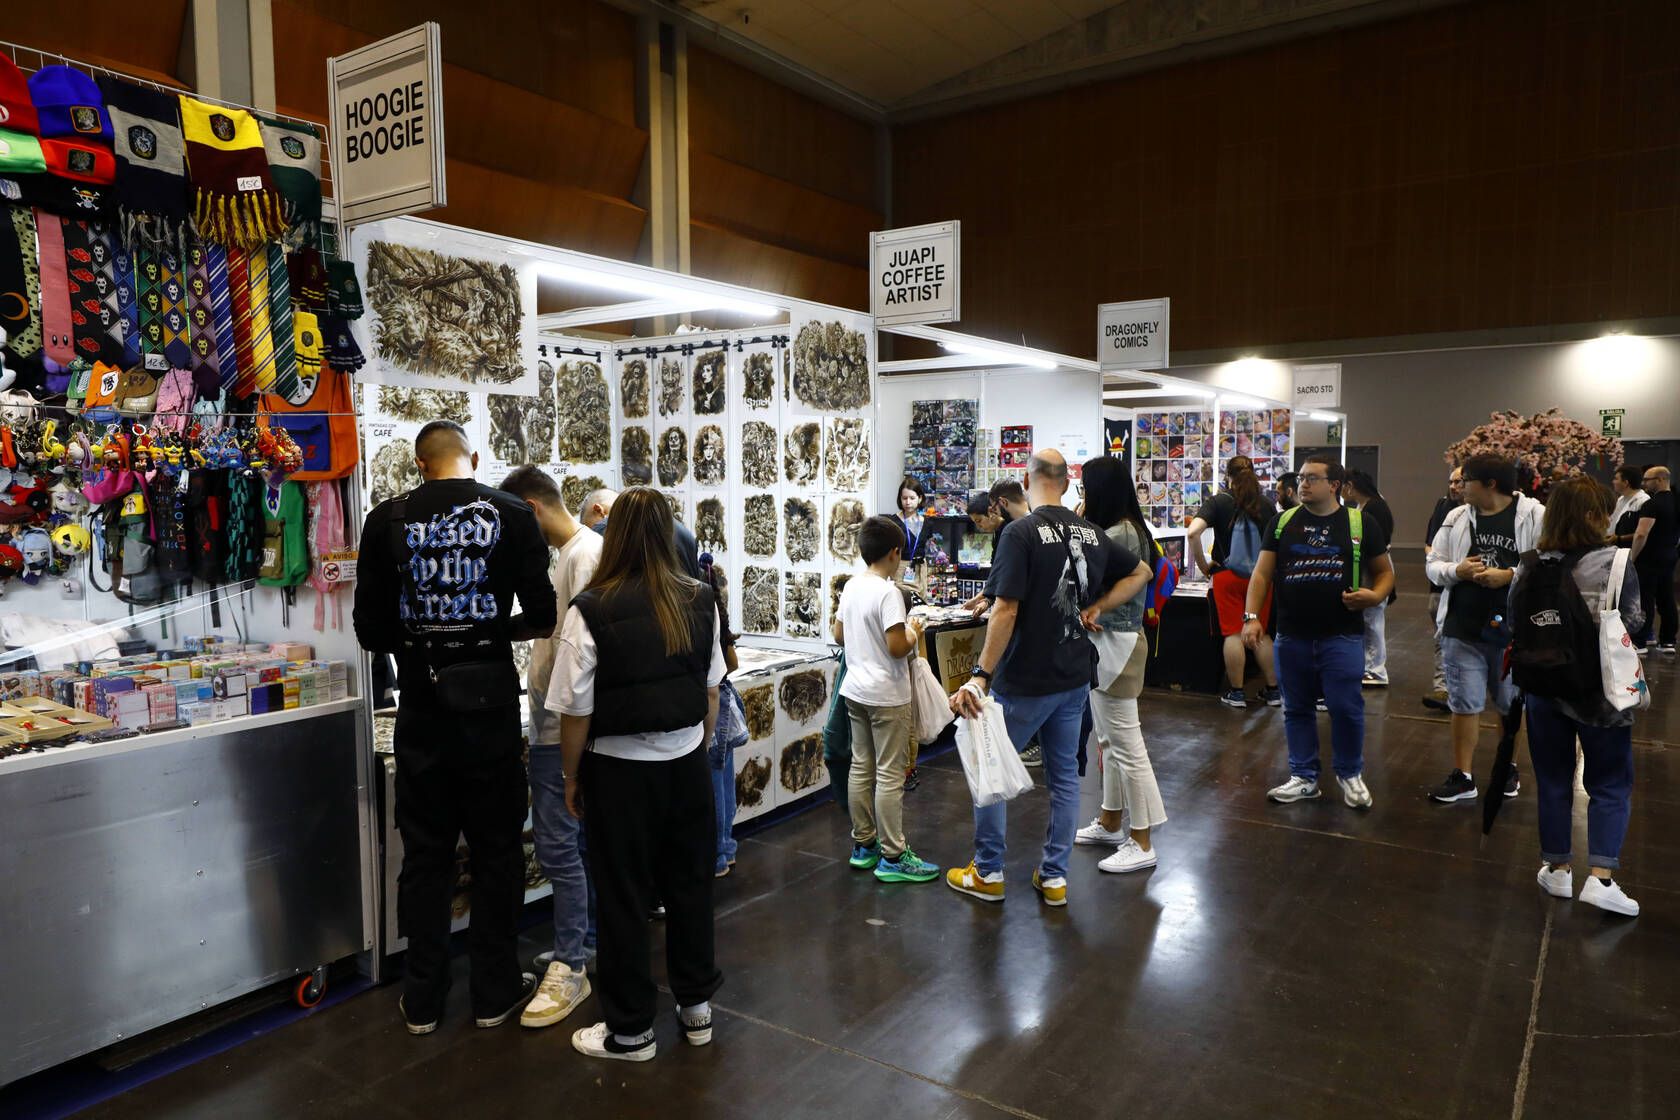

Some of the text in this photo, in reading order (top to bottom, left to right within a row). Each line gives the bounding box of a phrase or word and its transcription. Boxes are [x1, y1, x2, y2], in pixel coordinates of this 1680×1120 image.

[346, 81, 424, 130] HOOGIE
[346, 116, 424, 163] BOOGIE
[889, 246, 935, 268] JUAPI
[882, 264, 945, 287] COFFEE
[885, 283, 942, 305] ARTIST
[1105, 321, 1159, 337] DRAGONFLY
[1113, 335, 1149, 348] COMICS
[1296, 384, 1334, 394] SACRO STD
[402, 512, 494, 550] aised
